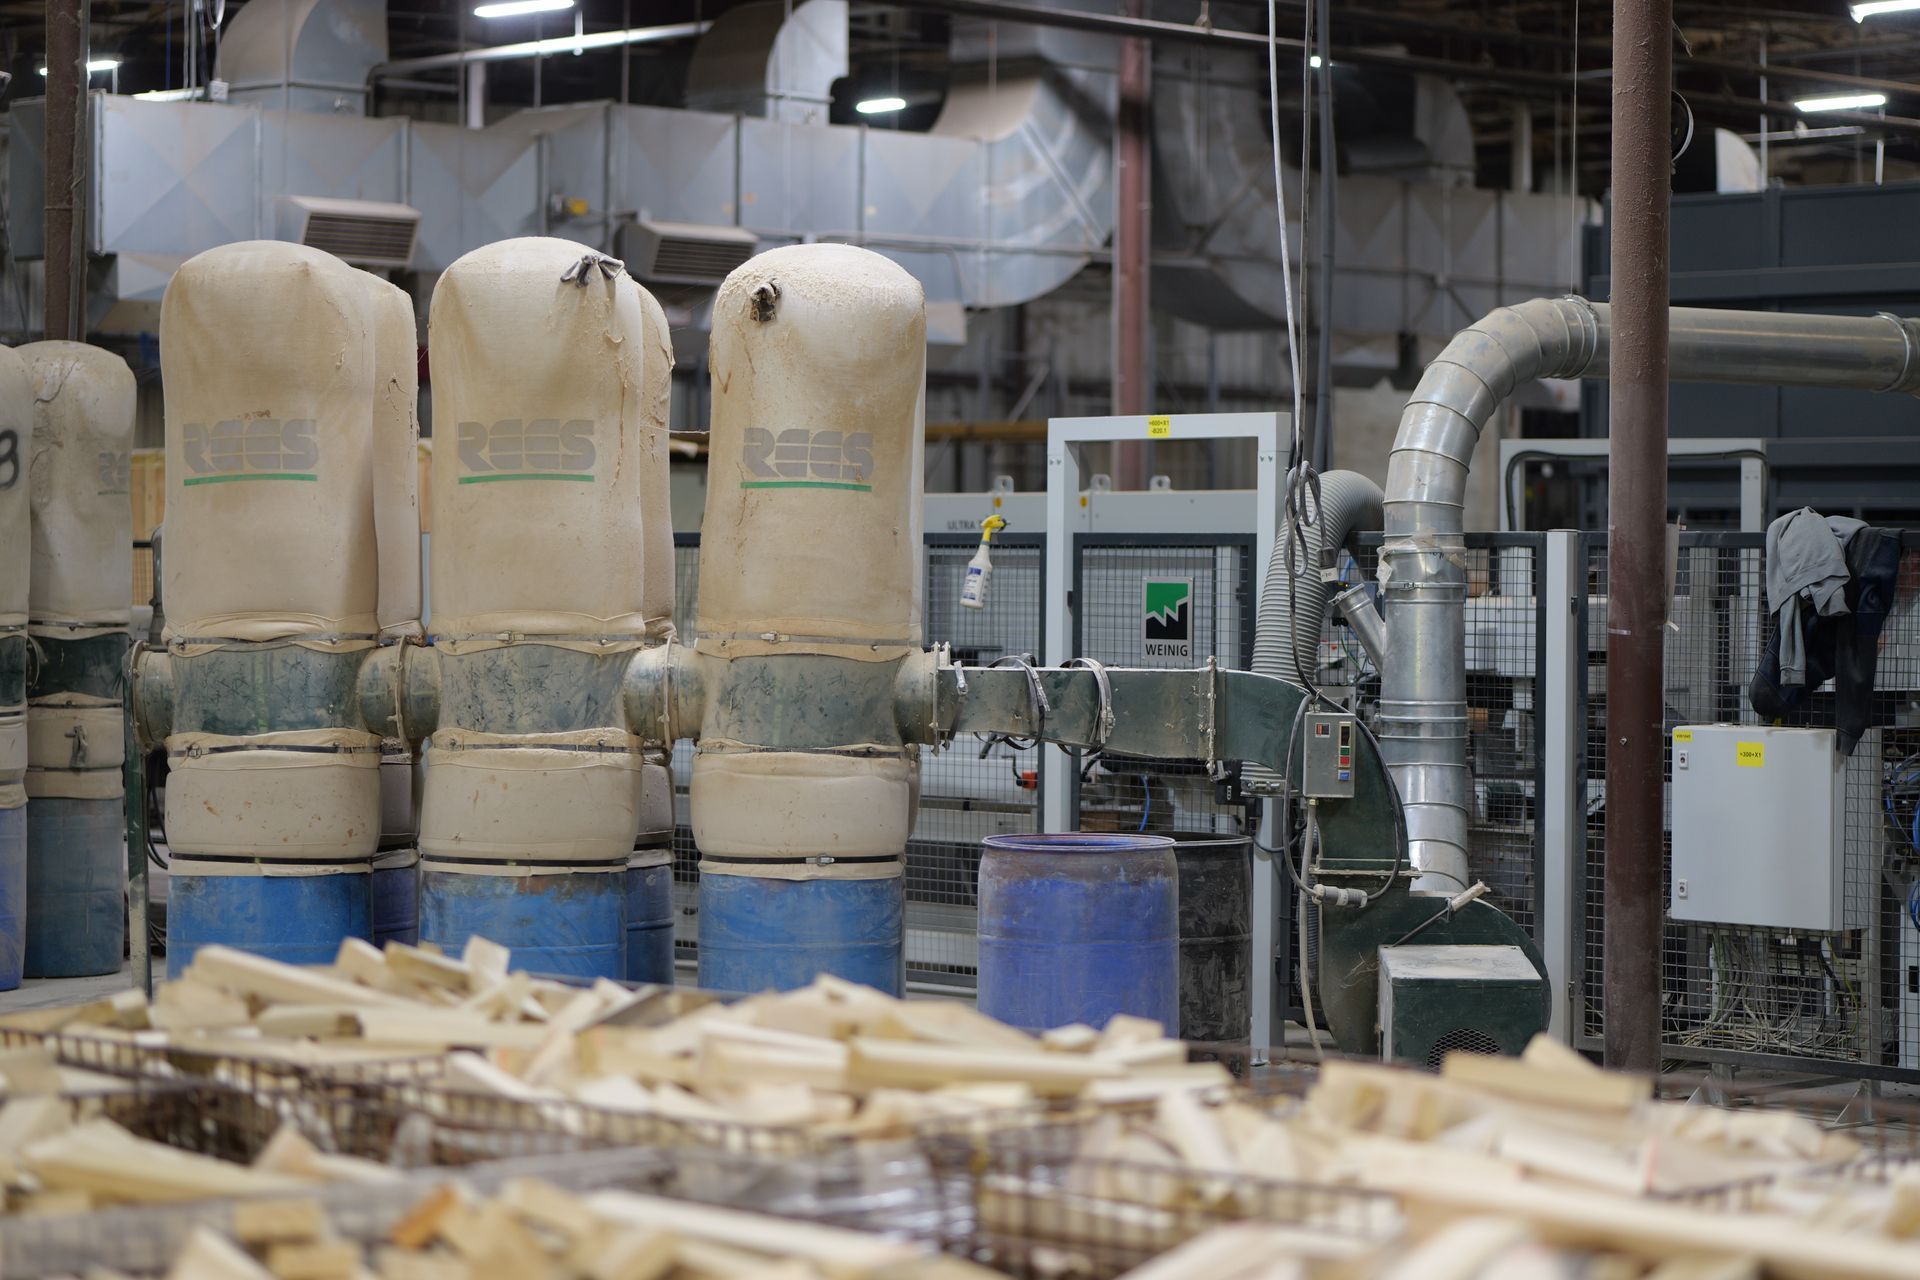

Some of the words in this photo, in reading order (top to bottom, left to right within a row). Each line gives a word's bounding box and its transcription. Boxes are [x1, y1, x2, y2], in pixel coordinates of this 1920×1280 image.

[183, 418, 319, 473] REES
[457, 418, 596, 472] REES
[742, 427, 874, 480] REES
[1145, 643, 1188, 657] WEINIG
